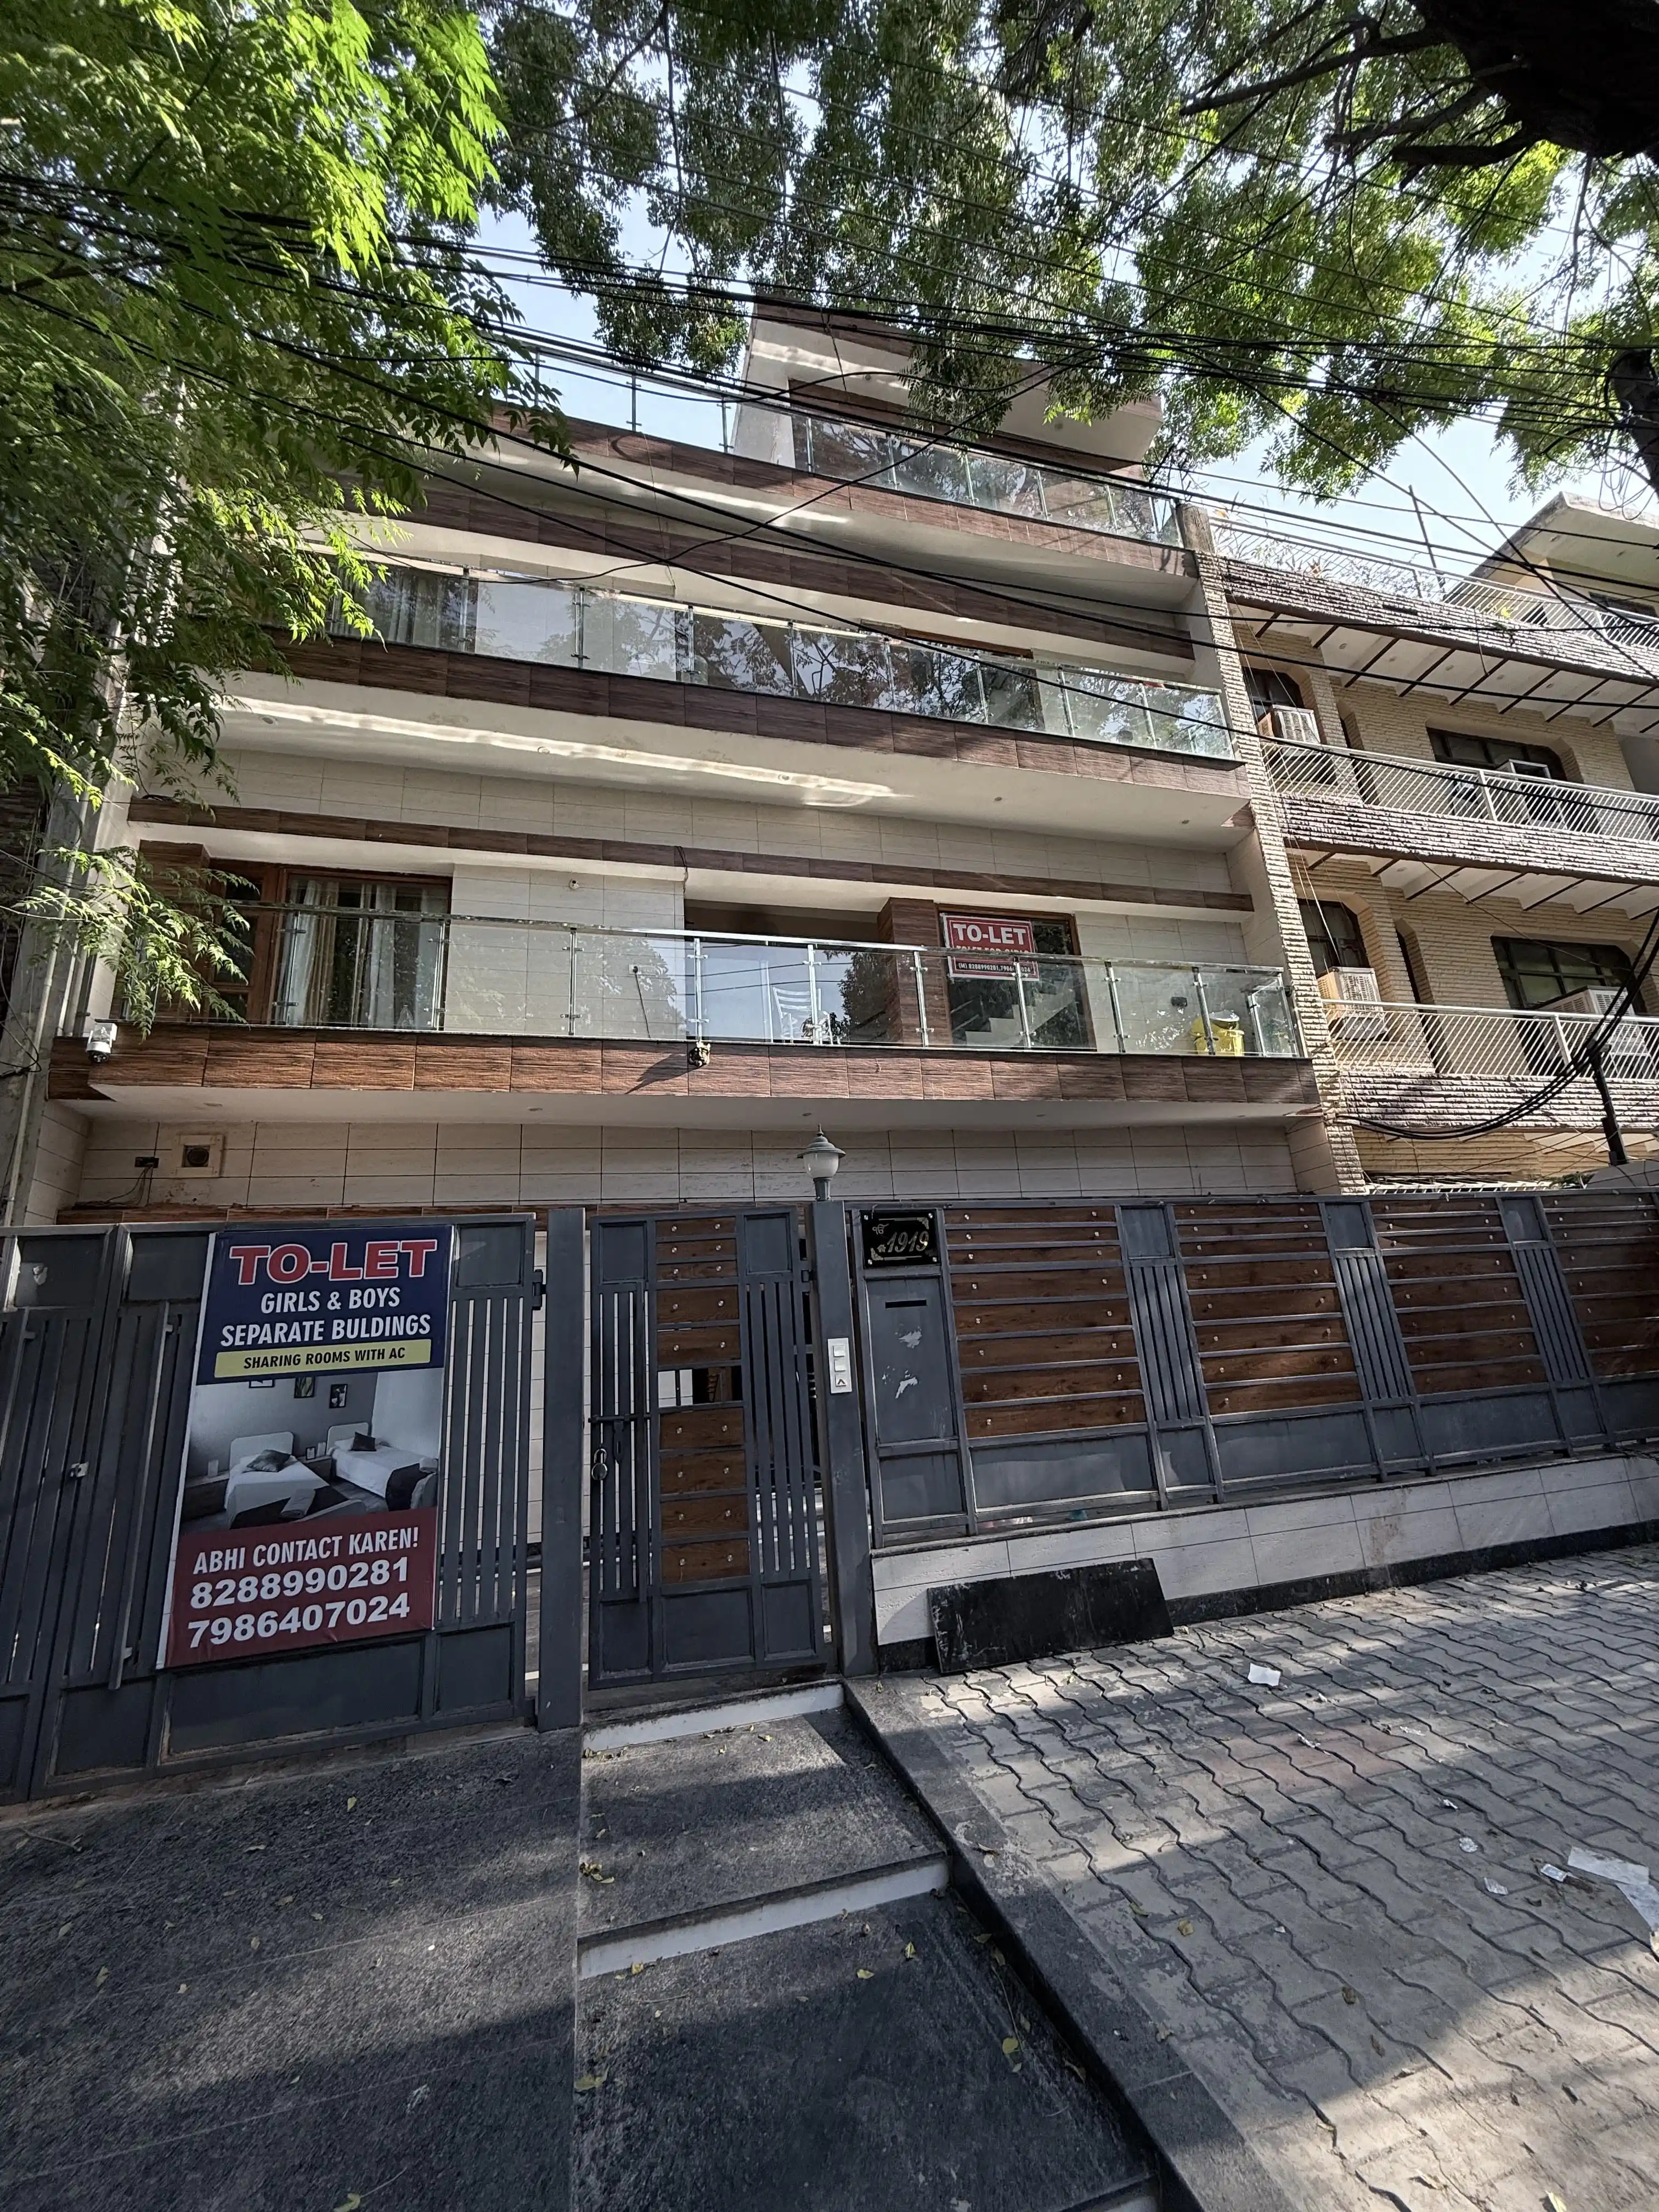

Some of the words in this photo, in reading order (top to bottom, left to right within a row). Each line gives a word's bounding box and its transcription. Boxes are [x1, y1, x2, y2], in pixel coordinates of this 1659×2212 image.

[953, 924, 1025, 945] TO-LET
[887, 1231, 929, 1252] 1919
[229, 1239, 438, 1285] TO-LET
[261, 1290, 321, 1314] GIRLS
[327, 1291, 342, 1311] &
[348, 1287, 401, 1308] BOYS
[221, 1319, 325, 1347] SEPARATE
[331, 1314, 431, 1340] BULDINGS
[243, 1353, 302, 1370] SHARING
[306, 1350, 351, 1366] ROOMS
[355, 1348, 386, 1362] WITH
[388, 1347, 405, 1359] AC
[194, 1549, 245, 1574] ABHI
[253, 1536, 343, 1566] CONTACT
[190, 1556, 409, 1609] 8288990281
[188, 1592, 410, 1648] 7986407024
